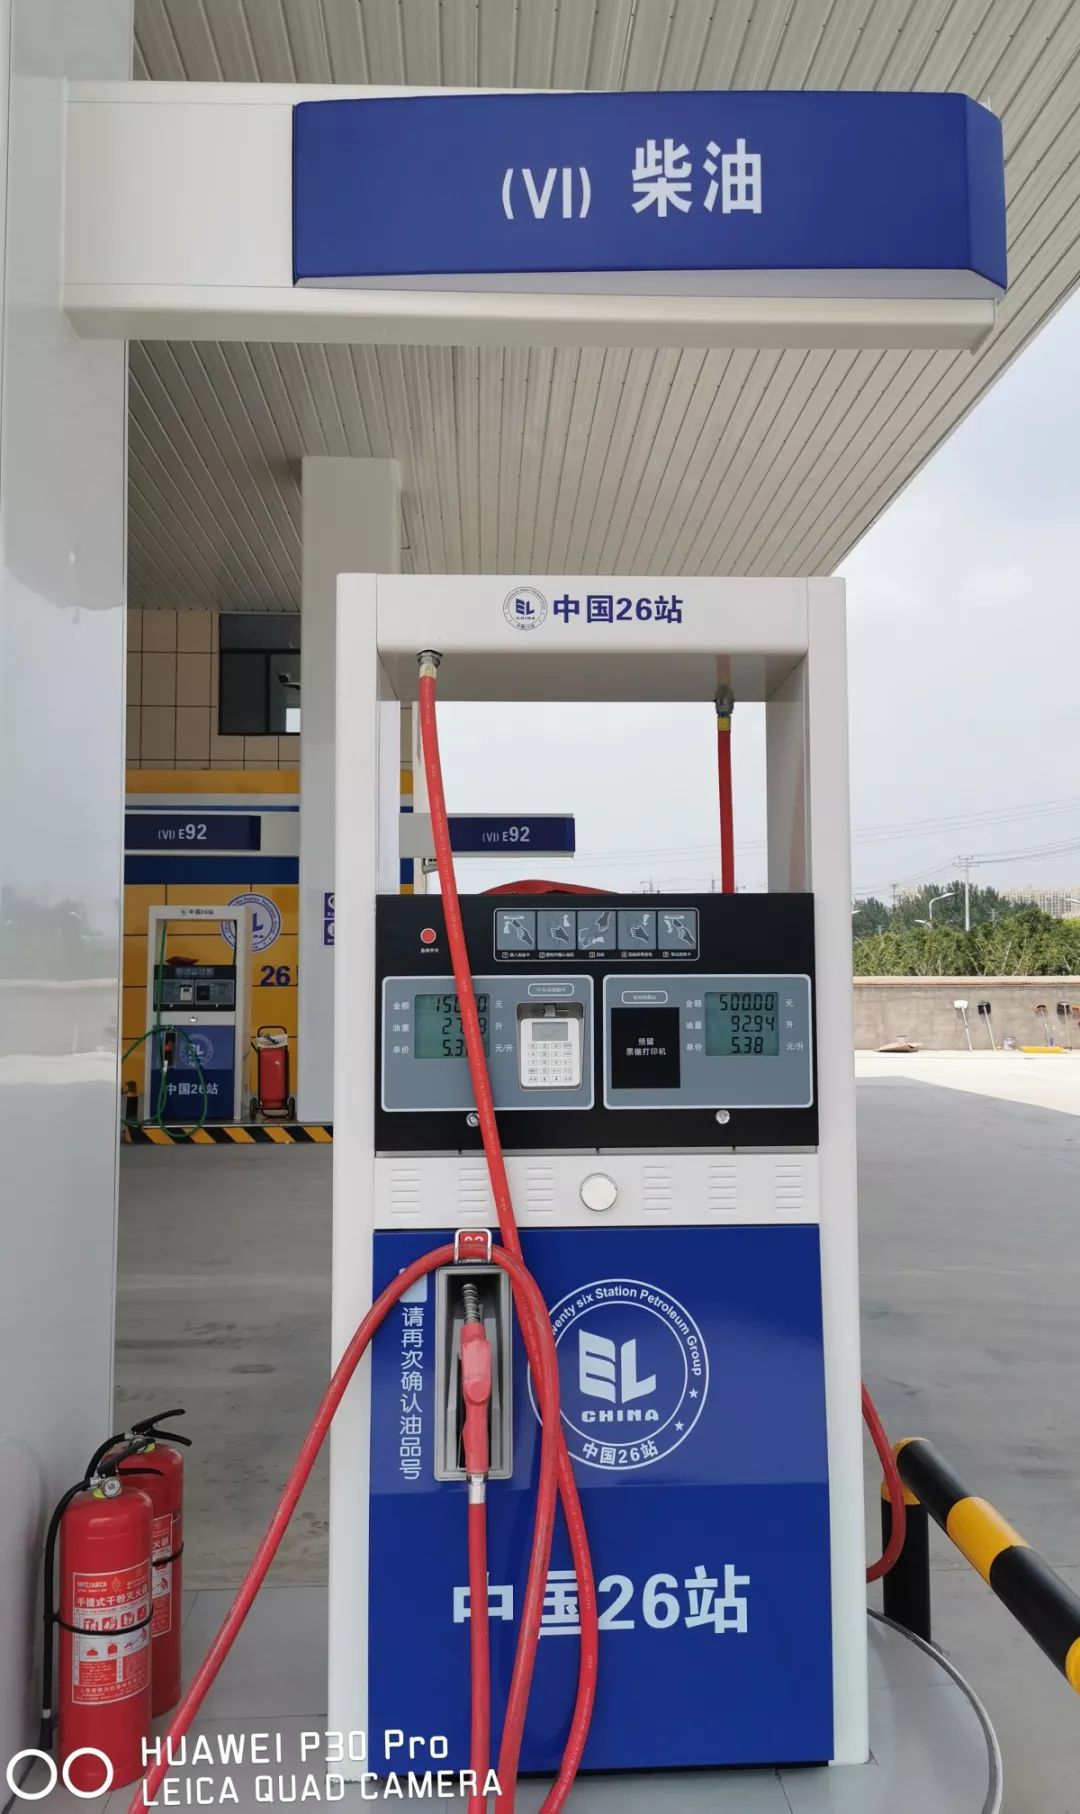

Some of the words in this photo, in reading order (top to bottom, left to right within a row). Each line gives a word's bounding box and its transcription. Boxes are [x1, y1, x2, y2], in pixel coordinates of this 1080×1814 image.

[631, 138, 762, 217] 柴油
[553, 594, 684, 624] 中国26站
[178, 823, 207, 840] E92
[502, 826, 530, 842] E92
[731, 1014, 775, 1032] 92.94
[731, 1036, 764, 1054] 5.38
[576, 1293, 594, 1308] six
[595, 1285, 637, 1299] Station
[639, 1289, 690, 1335] Petroleum
[686, 1335, 702, 1376] Group
[399, 1306, 424, 1480] 请再次确认油品号
[581, 1408, 659, 1422] CHINA
[582, 1440, 659, 1465] 中国26站
